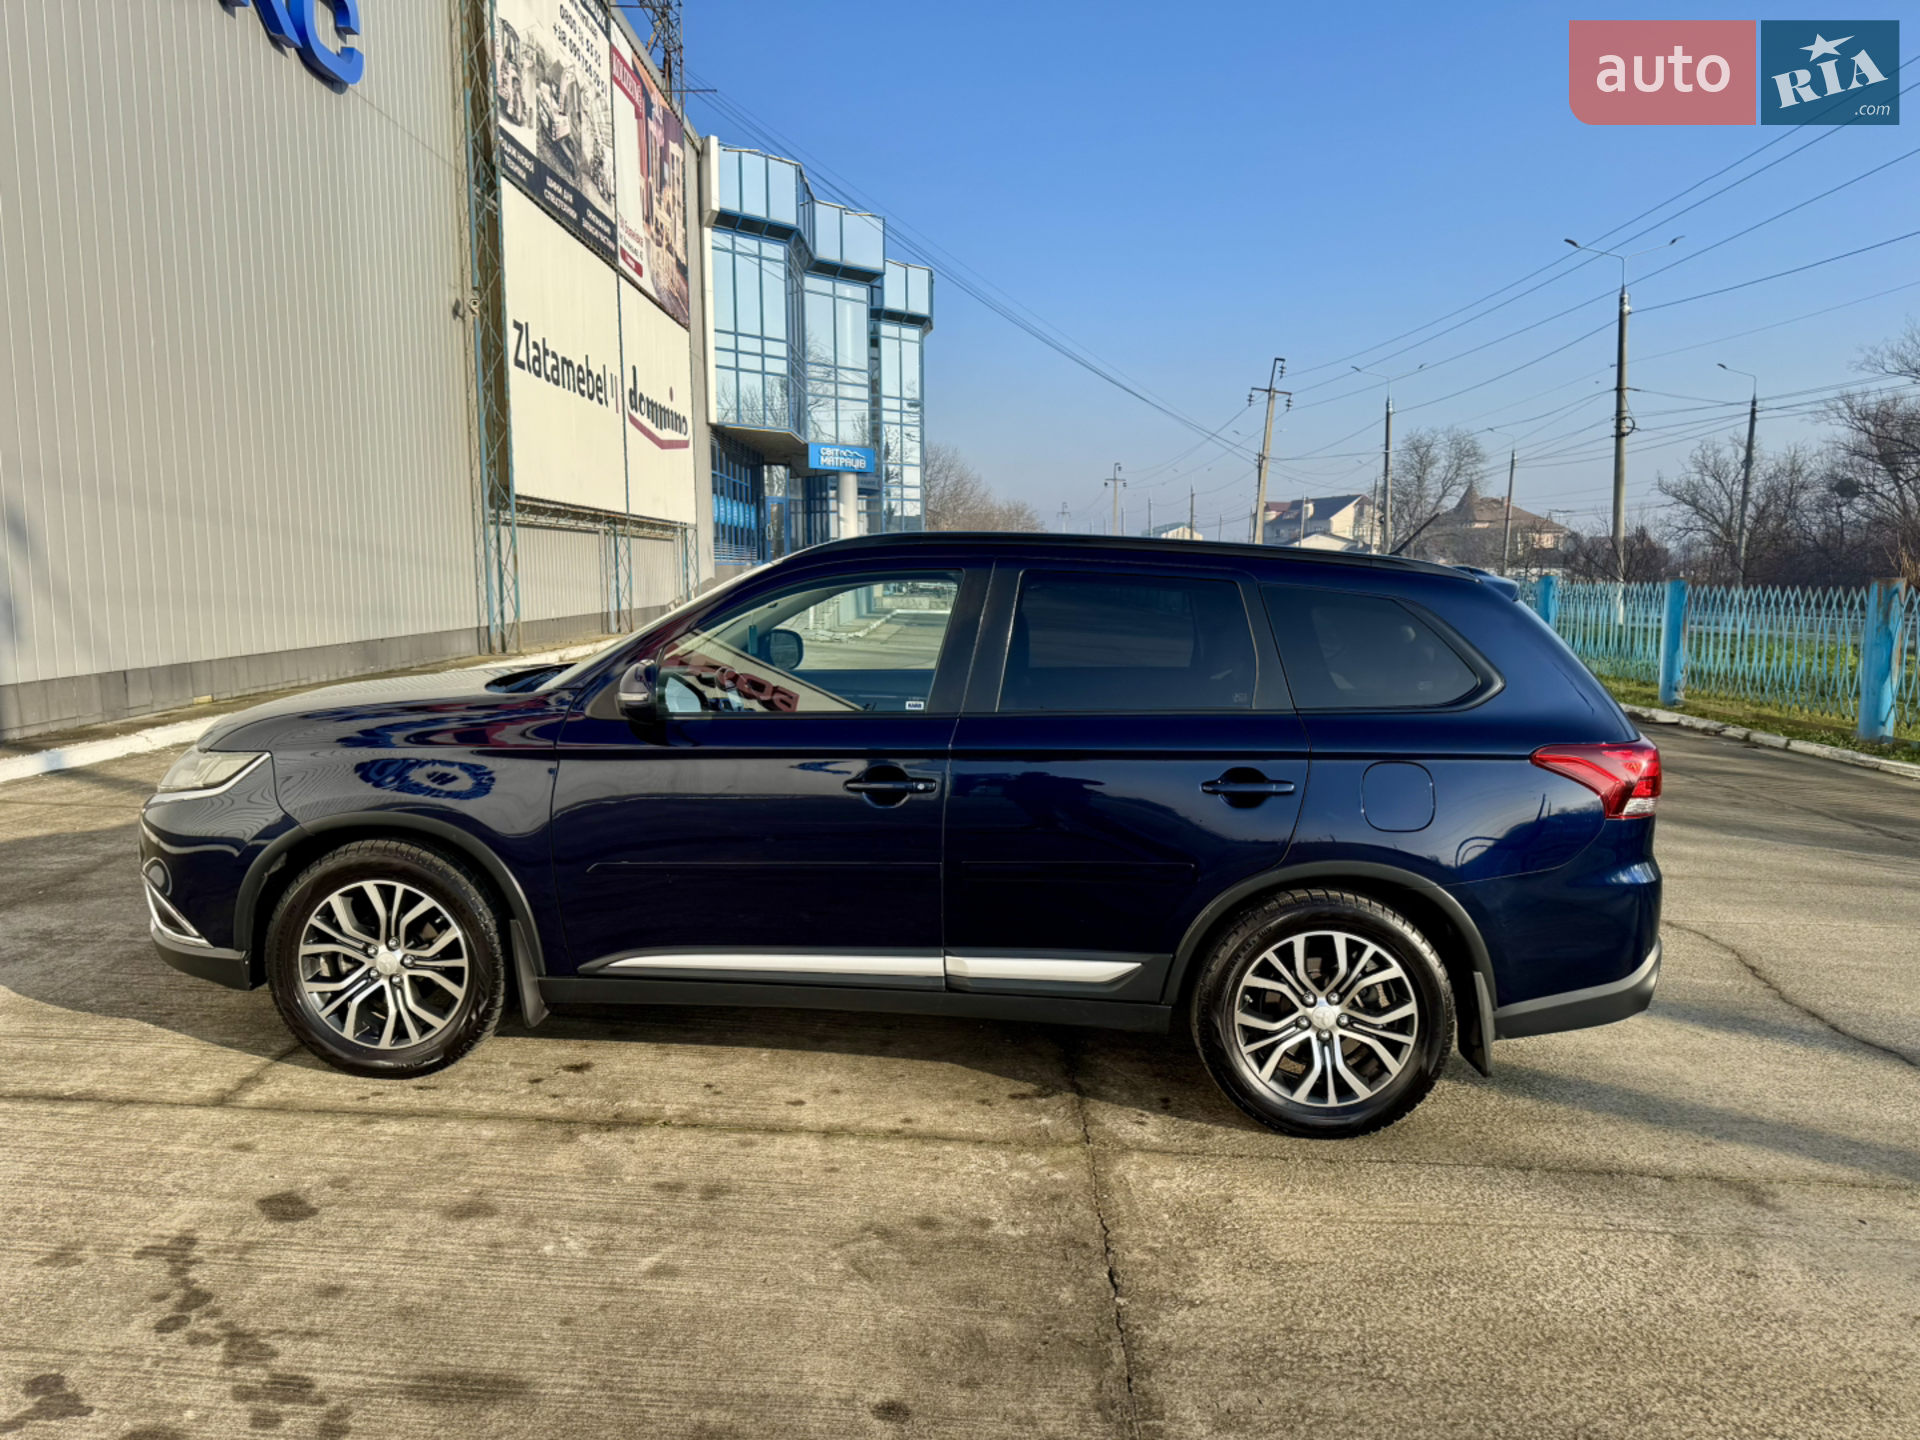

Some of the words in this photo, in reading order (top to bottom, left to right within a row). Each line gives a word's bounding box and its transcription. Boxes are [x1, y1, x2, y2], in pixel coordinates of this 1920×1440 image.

[512, 319, 609, 408] Zlatamebel
[628, 365, 689, 436] dommino
[820, 456, 866, 470] МАТРАЦІВ
